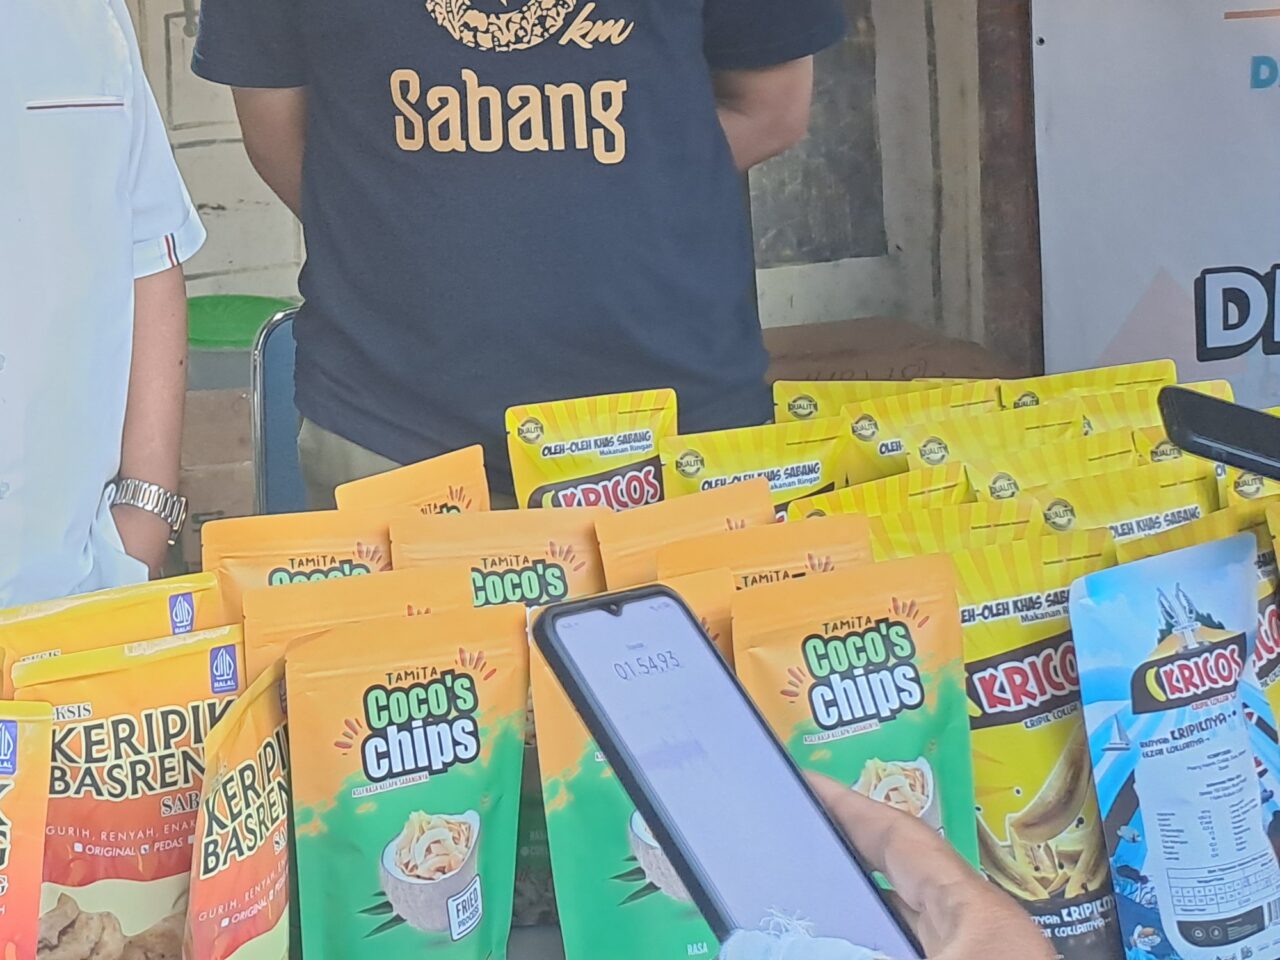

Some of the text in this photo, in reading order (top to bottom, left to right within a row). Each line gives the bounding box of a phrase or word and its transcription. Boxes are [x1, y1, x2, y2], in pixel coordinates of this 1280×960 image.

[389, 68, 627, 164] Sabang
[616, 431, 652, 445] SABANG
[783, 462, 820, 478] SABANG
[1163, 506, 1201, 528] SABANG
[472, 564, 565, 607] Coco's
[1013, 595, 1043, 612] KHAS
[1021, 609, 1061, 623] Makanan
[805, 623, 912, 677] Coco's
[977, 645, 1080, 709] KRICO
[1163, 647, 1241, 696] KRICOS
[367, 674, 475, 729] Coco's
[811, 665, 922, 727] chips
[364, 719, 478, 778] chips
[85, 838, 183, 857] ORIGINAL PEDAS
[455, 887, 479, 919] FRIED
[686, 942, 708, 956] RASA
